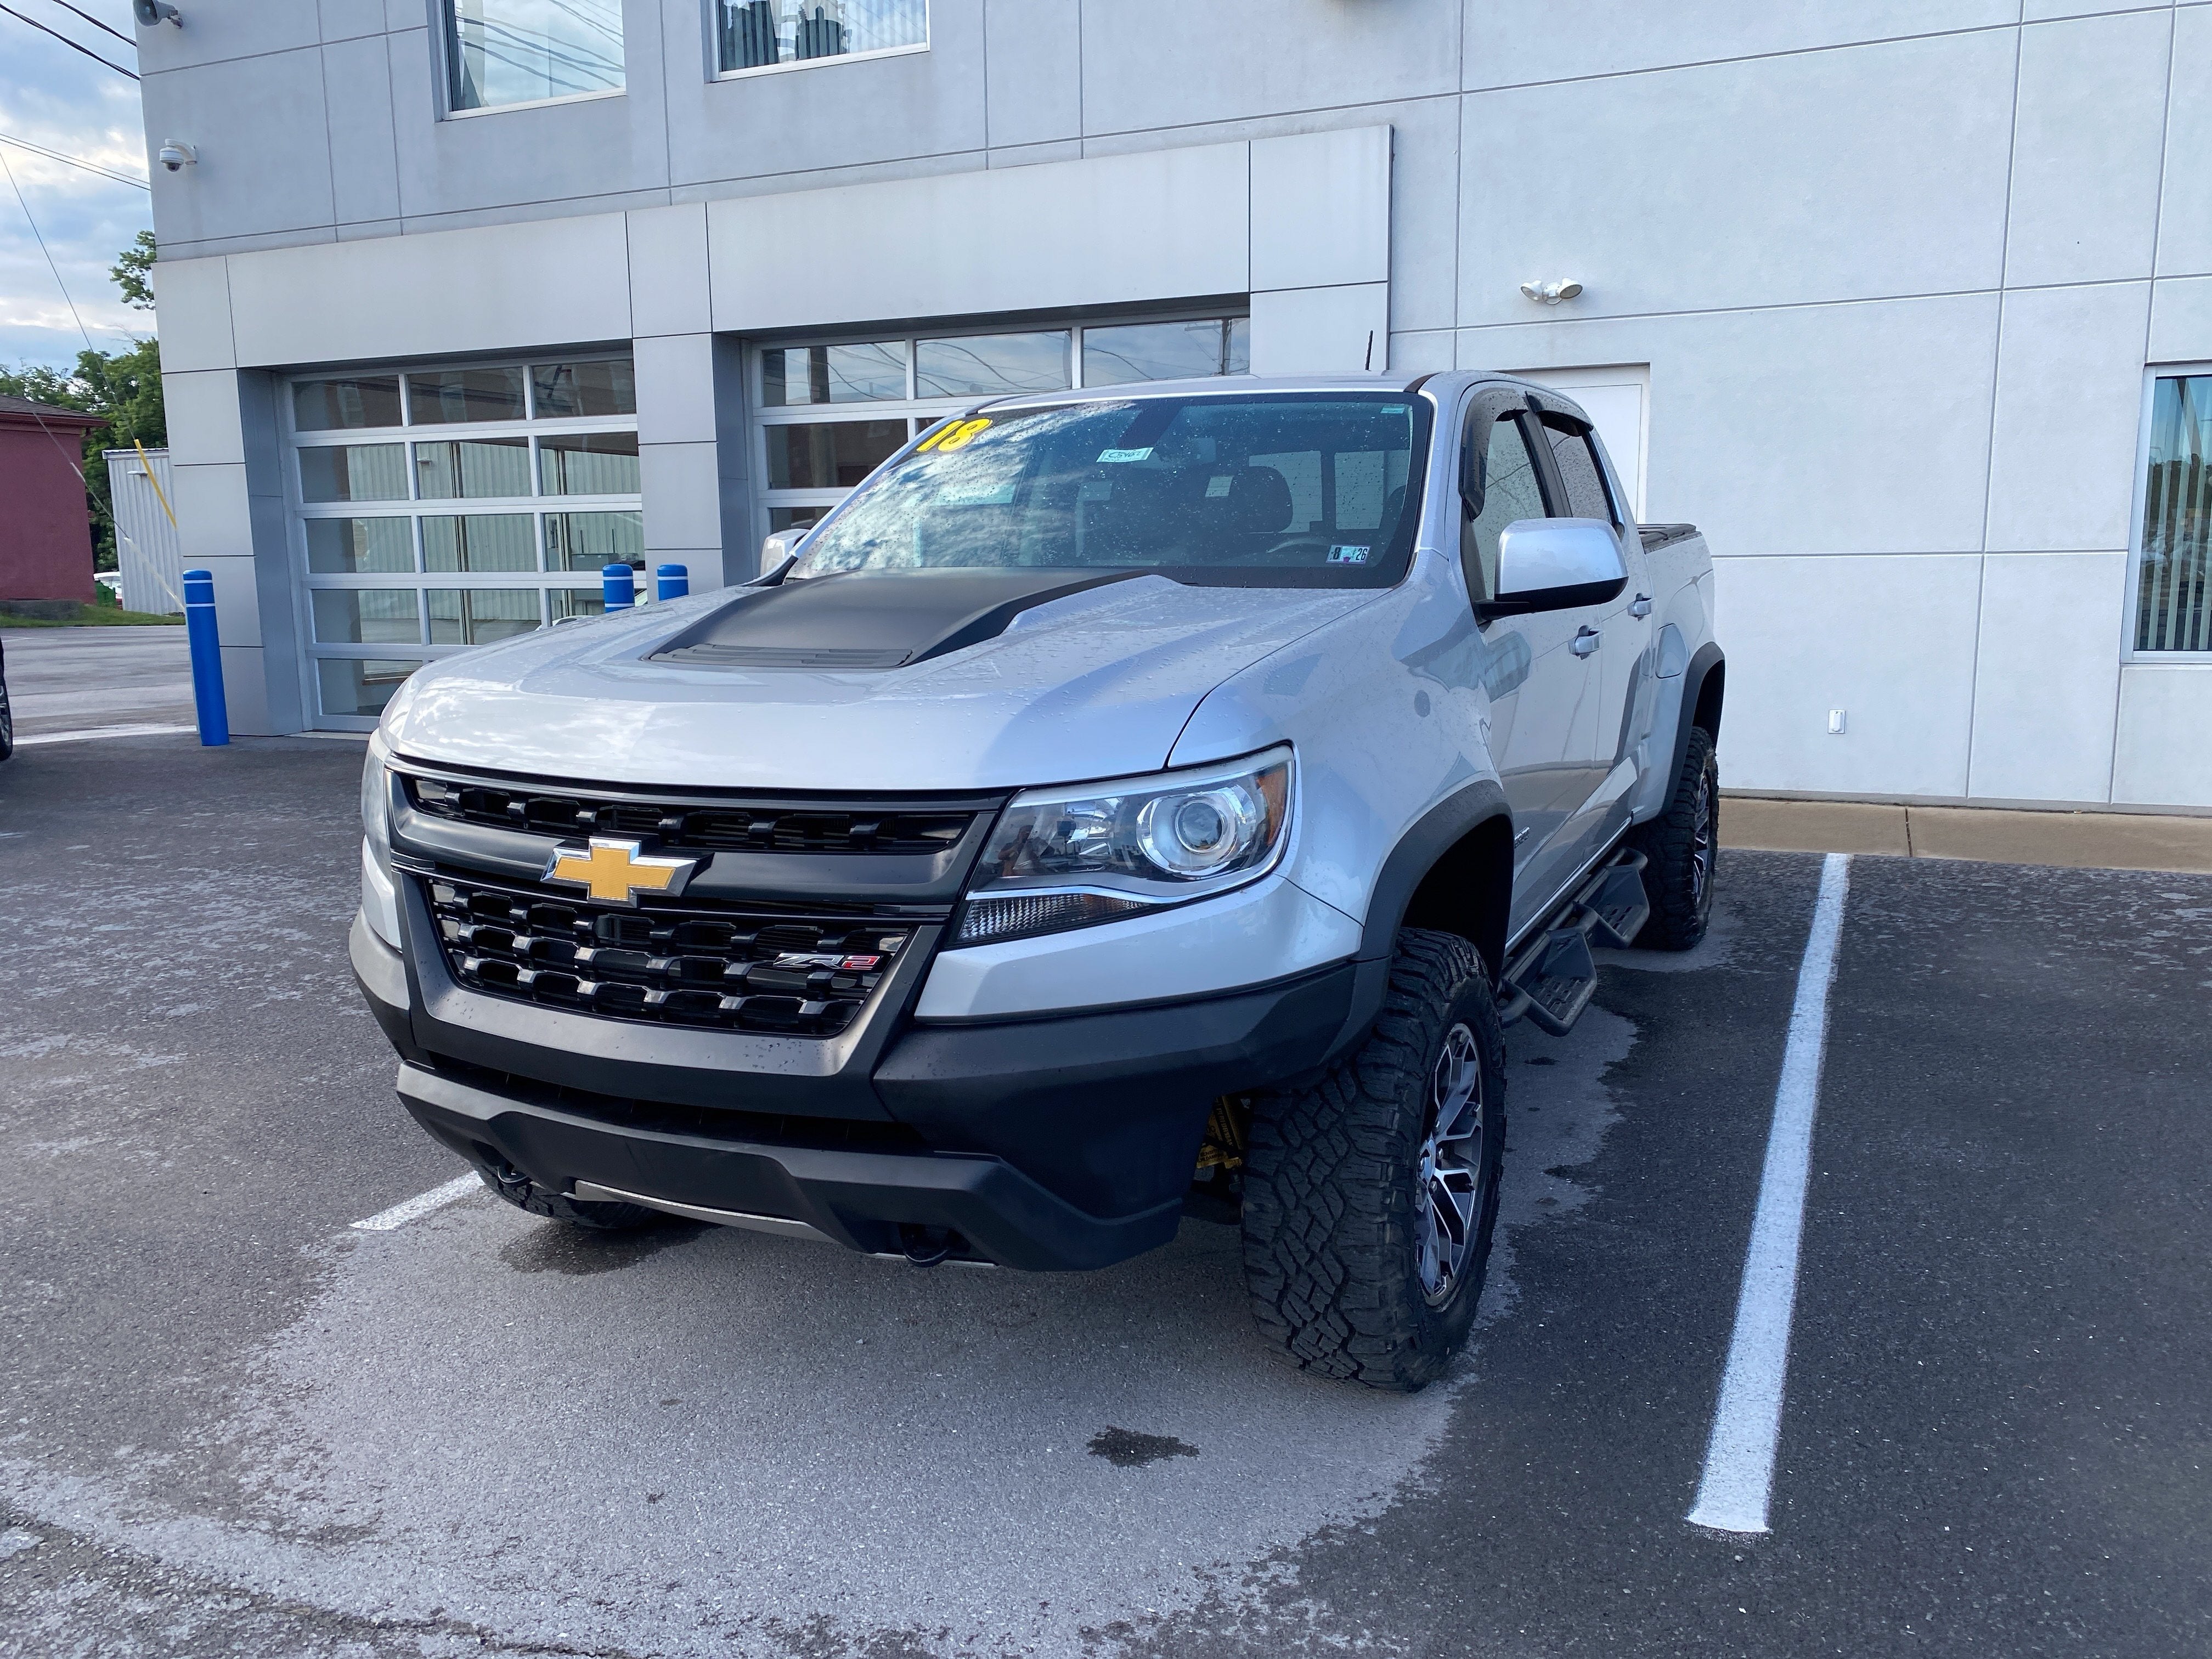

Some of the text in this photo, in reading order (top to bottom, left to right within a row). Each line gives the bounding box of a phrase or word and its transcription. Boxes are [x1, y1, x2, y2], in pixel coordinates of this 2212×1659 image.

[916, 418, 993, 452] 18
[1333, 547, 1368, 561] 8 26
[773, 953, 881, 970] ZR2
